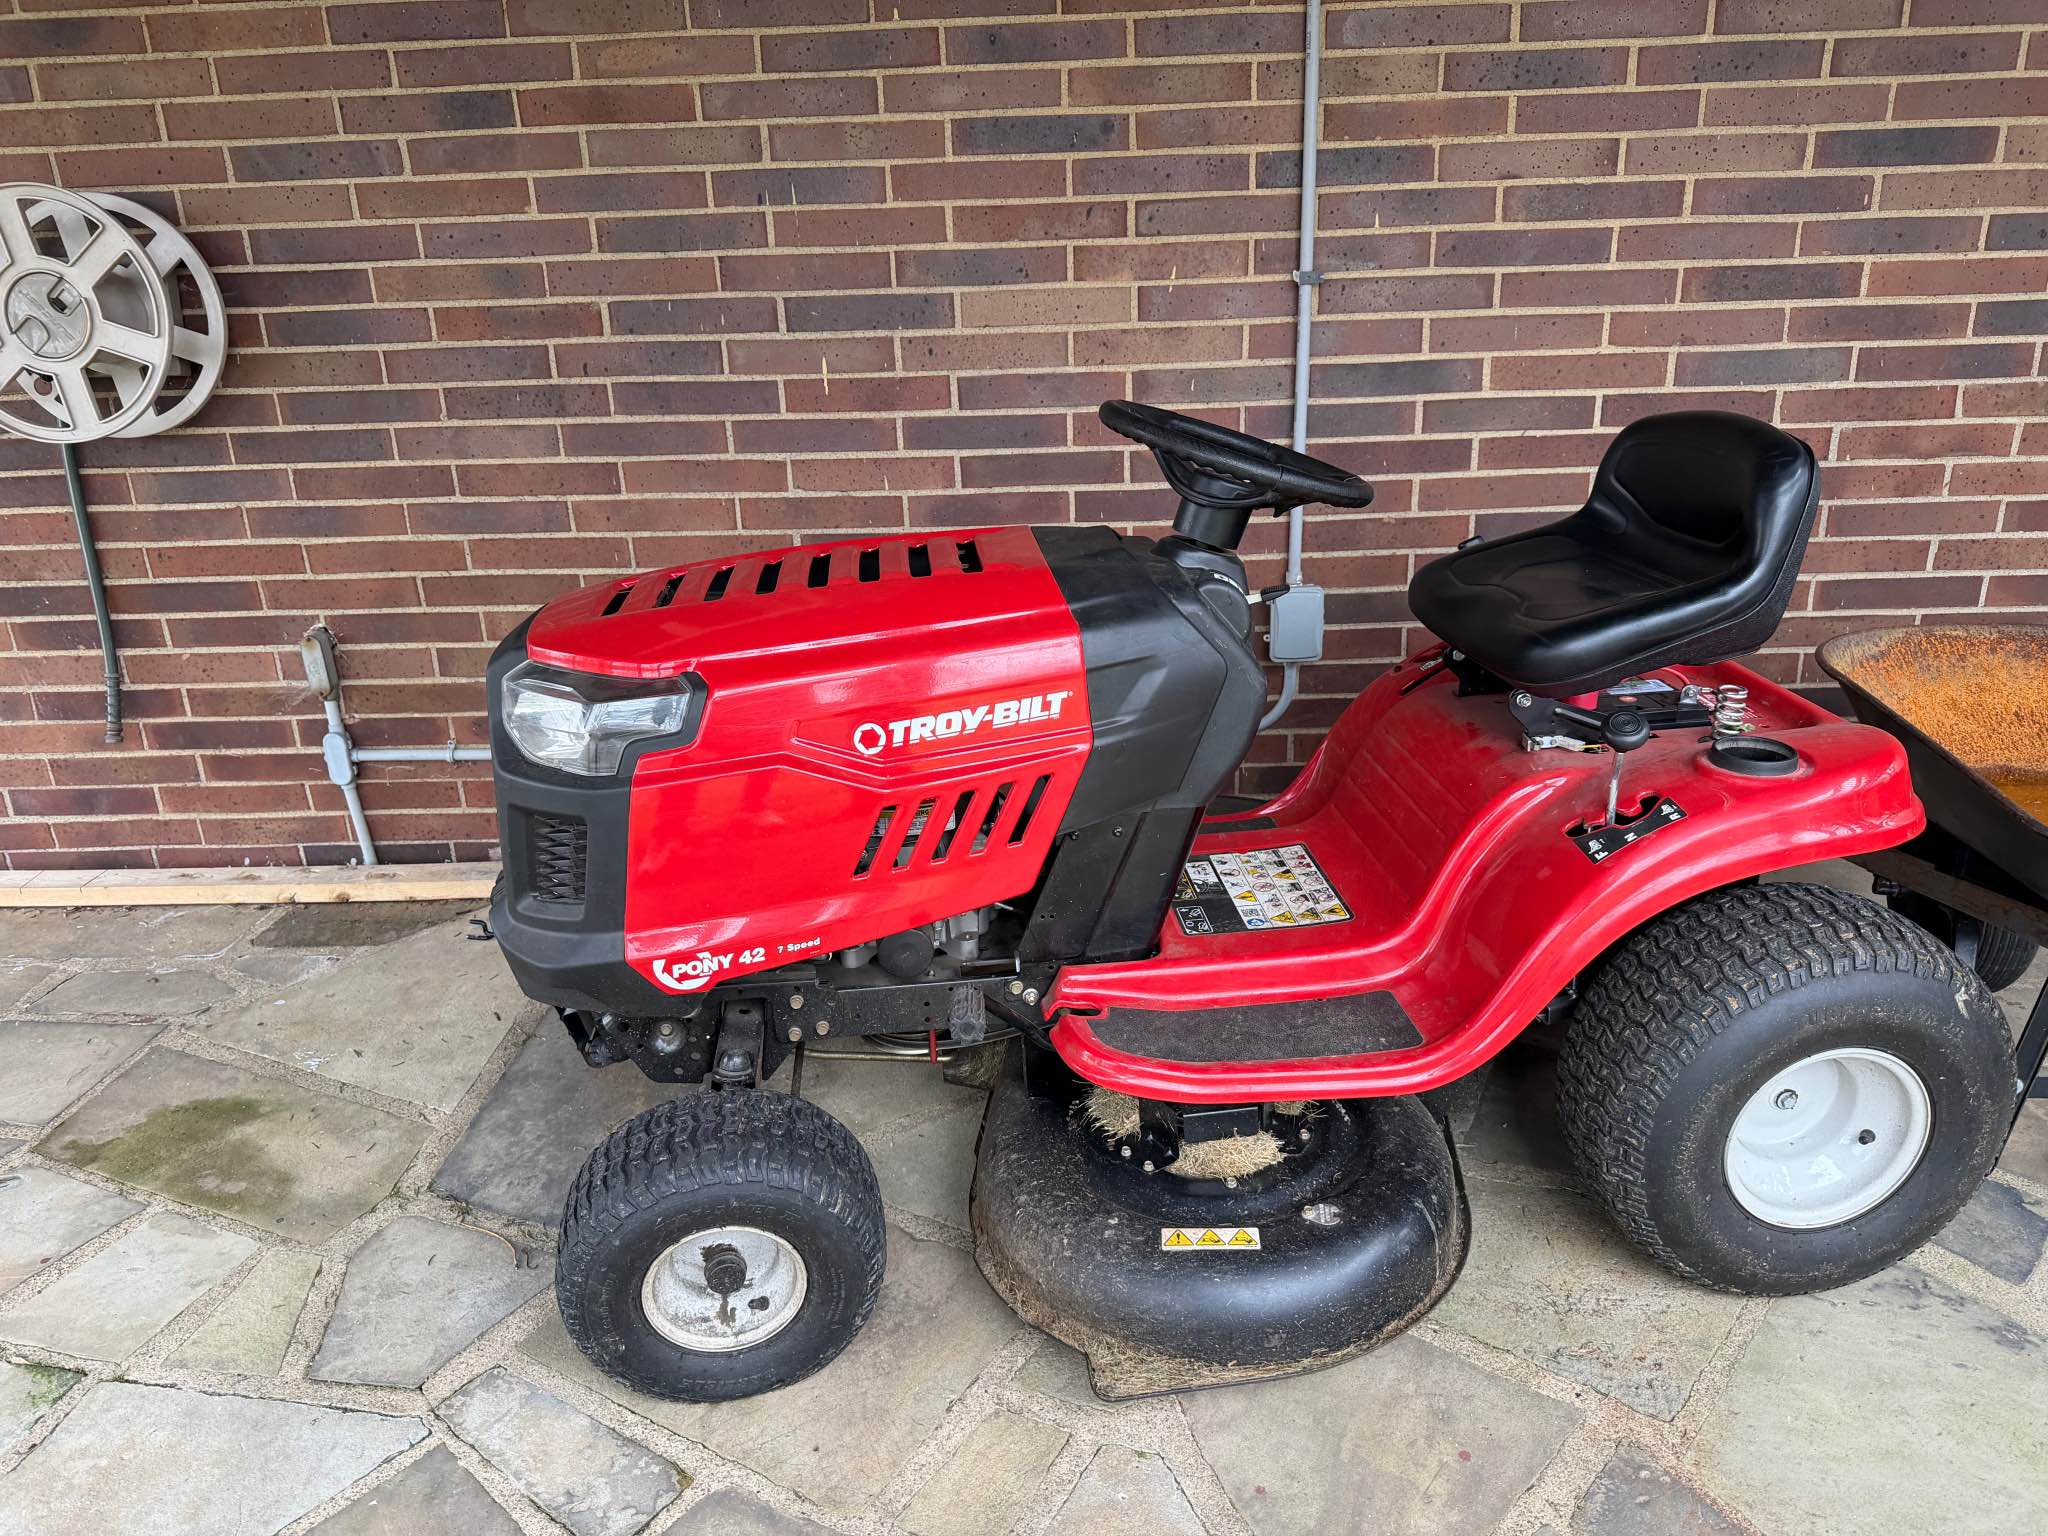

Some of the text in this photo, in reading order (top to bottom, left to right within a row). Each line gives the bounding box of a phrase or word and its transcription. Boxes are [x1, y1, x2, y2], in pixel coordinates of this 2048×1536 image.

[888, 691, 1068, 747] TROY-BILT
[777, 937, 821, 954] 7 Speed
[672, 947, 766, 978] PONY 42
